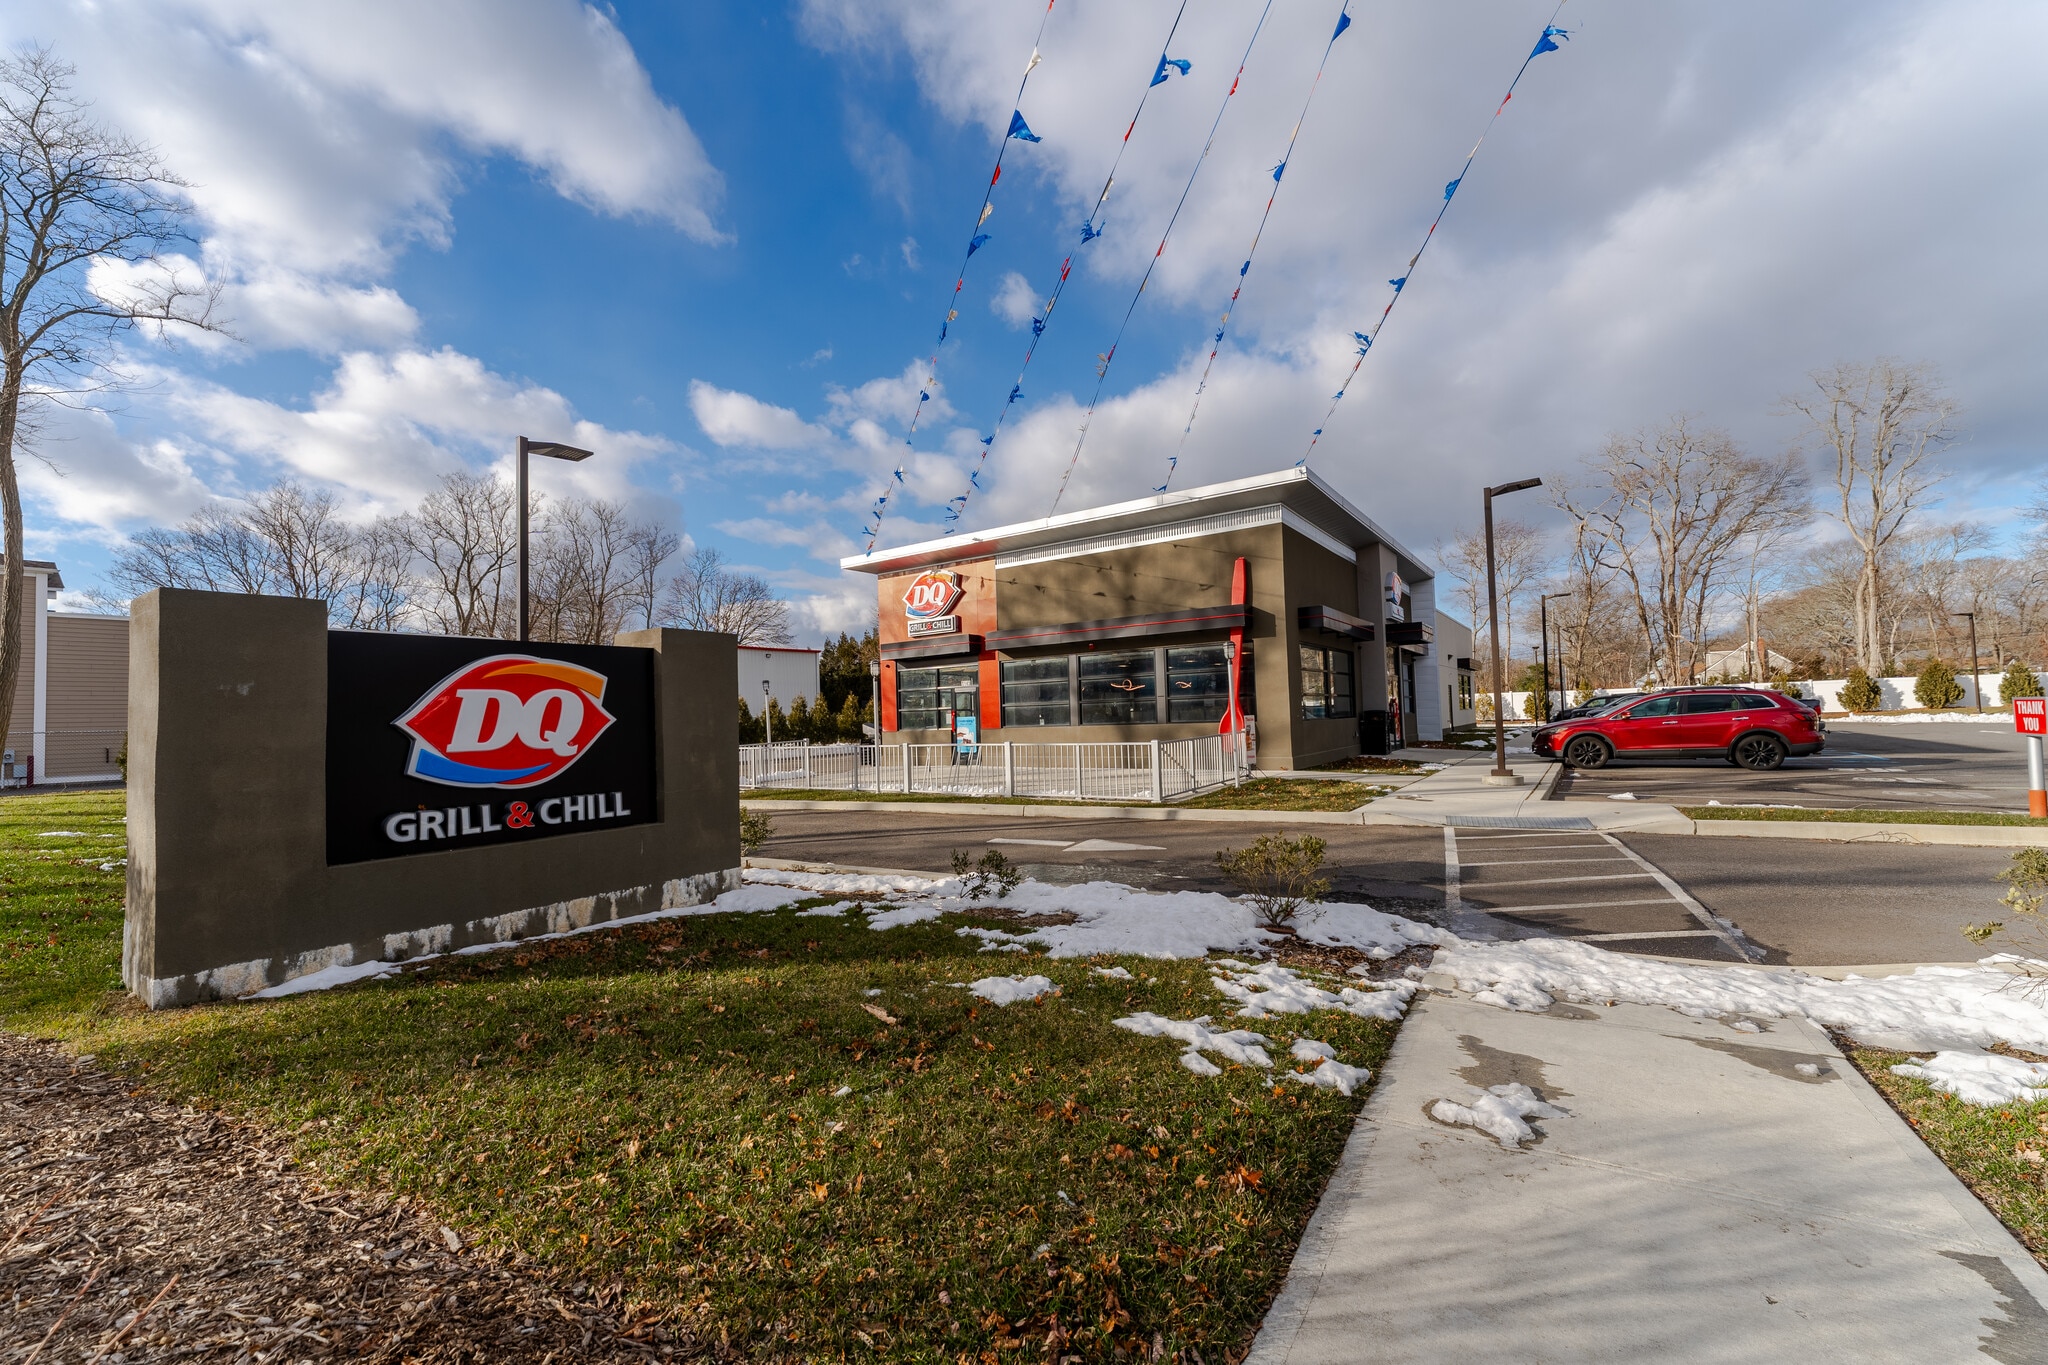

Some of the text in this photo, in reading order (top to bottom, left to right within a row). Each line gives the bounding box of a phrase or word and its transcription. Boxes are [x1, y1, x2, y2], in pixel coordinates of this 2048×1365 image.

[912, 582, 946, 607] DQ
[910, 623, 927, 632] GRILL
[933, 620, 951, 629] CHILL
[2016, 700, 2044, 715] THANK
[446, 688, 584, 757] DQ
[2023, 717, 2040, 731] YOU
[384, 791, 631, 843] GRILL & CHILL
